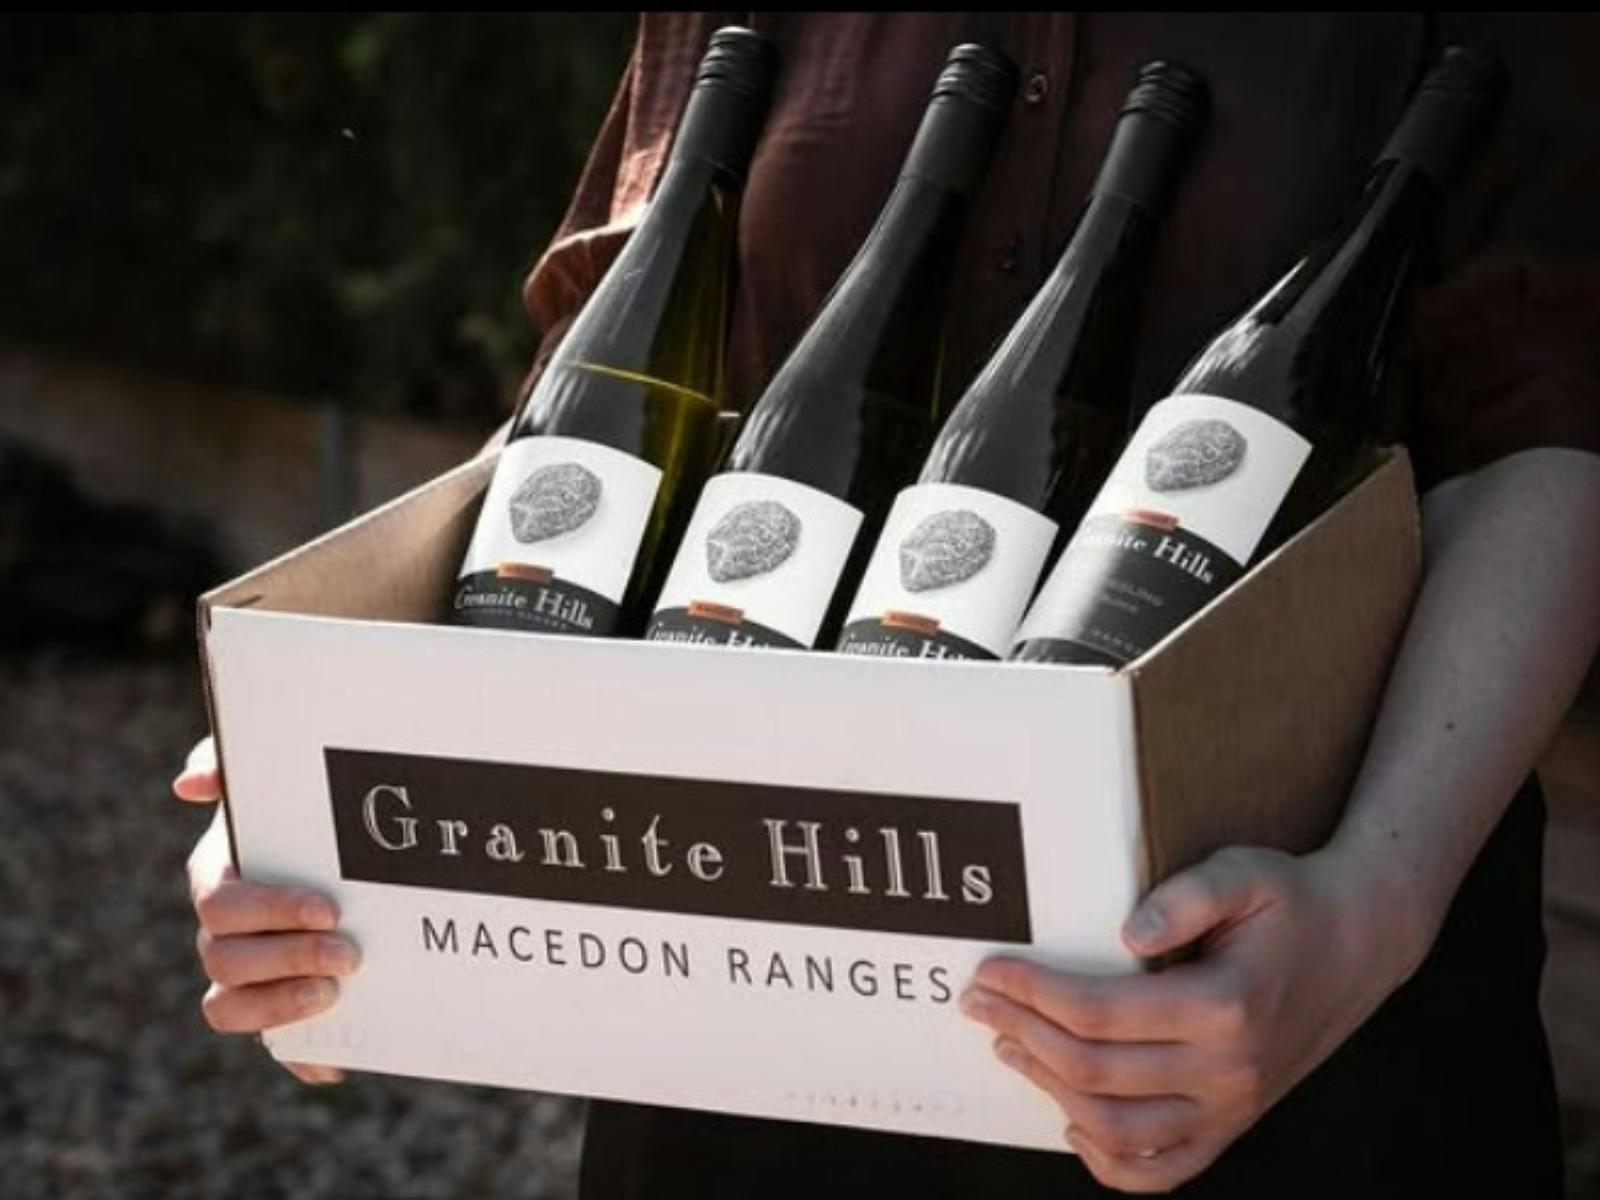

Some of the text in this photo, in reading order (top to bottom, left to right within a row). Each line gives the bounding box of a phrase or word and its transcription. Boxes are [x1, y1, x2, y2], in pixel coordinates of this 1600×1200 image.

[1153, 535, 1214, 585] Hills
[454, 585, 528, 610] Granite
[534, 588, 593, 630] Hills
[362, 784, 993, 904] Granite Hills
[421, 916, 952, 1004] MACEDON RANGES
